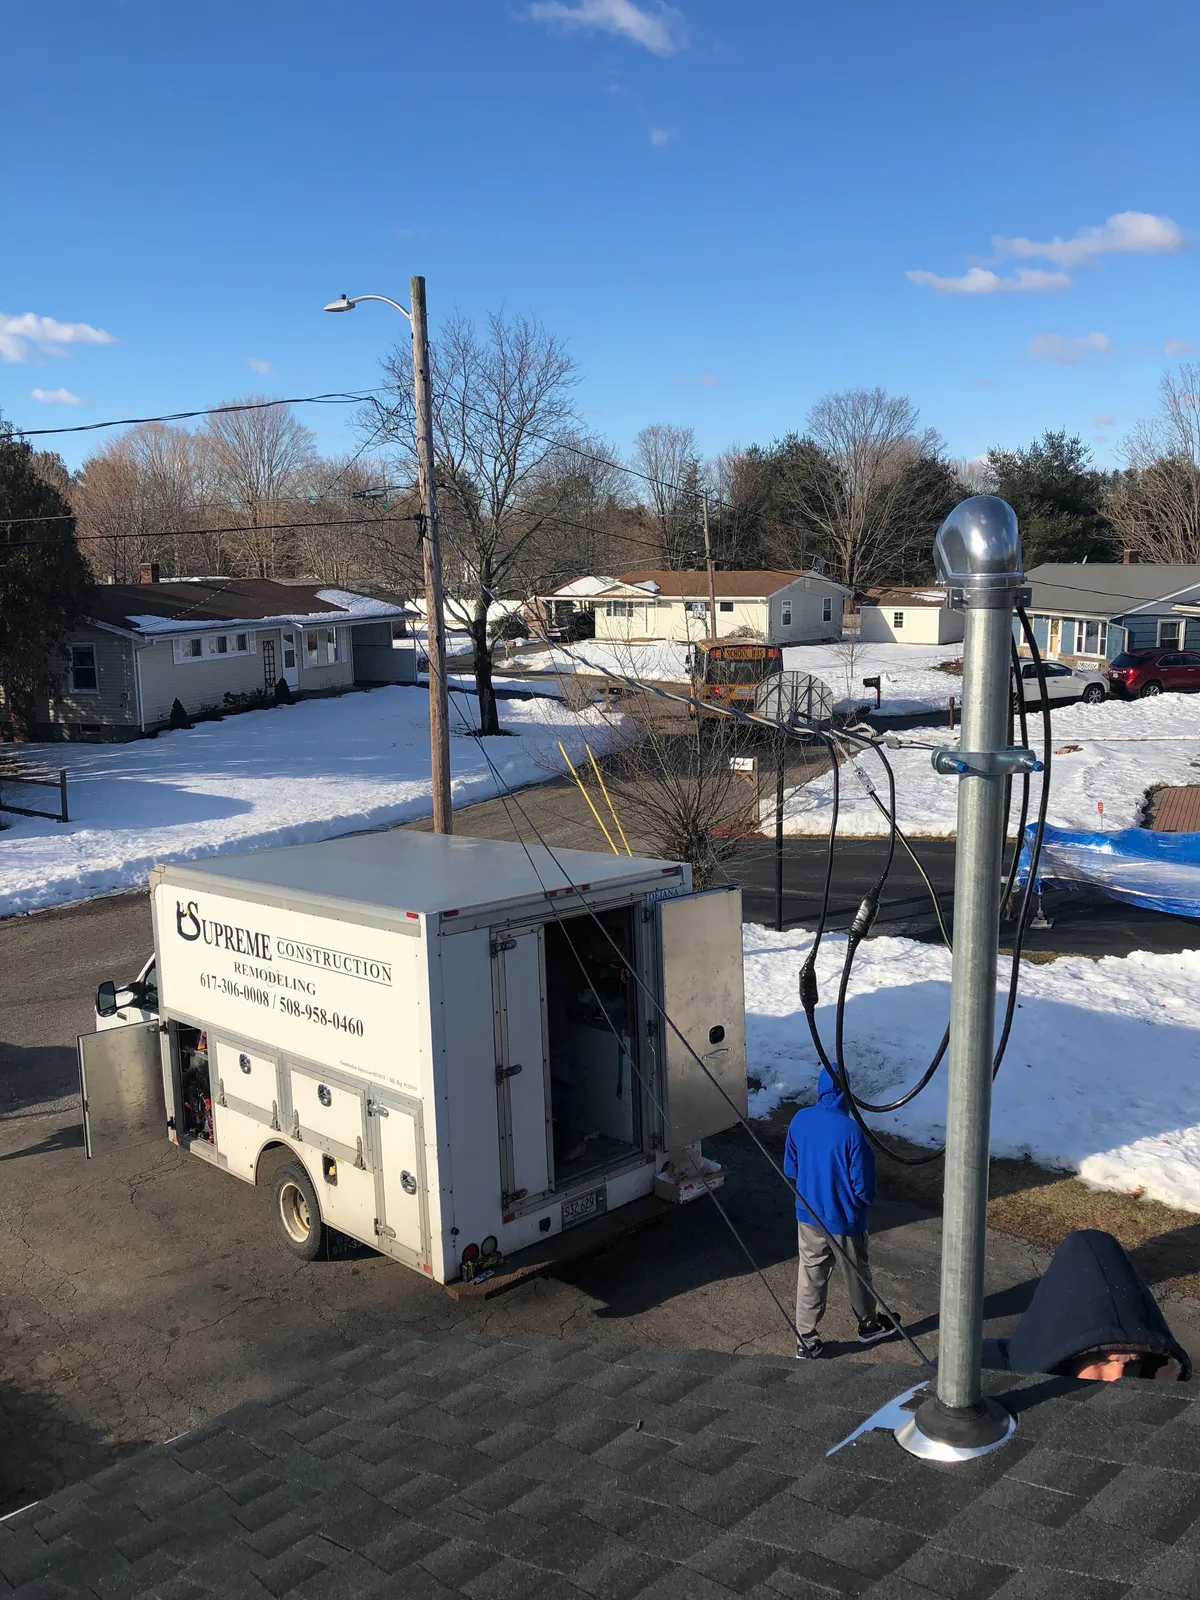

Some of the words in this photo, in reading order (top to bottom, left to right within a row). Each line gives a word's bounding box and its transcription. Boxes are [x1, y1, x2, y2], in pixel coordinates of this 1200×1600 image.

[176, 900, 272, 962] SUPREME
[276, 940, 392, 983] CONSTRUCTION
[200, 972, 269, 1007] 617-306-0008
[280, 996, 364, 1037] 508-958-0460
[233, 961, 316, 996] REMODELING
